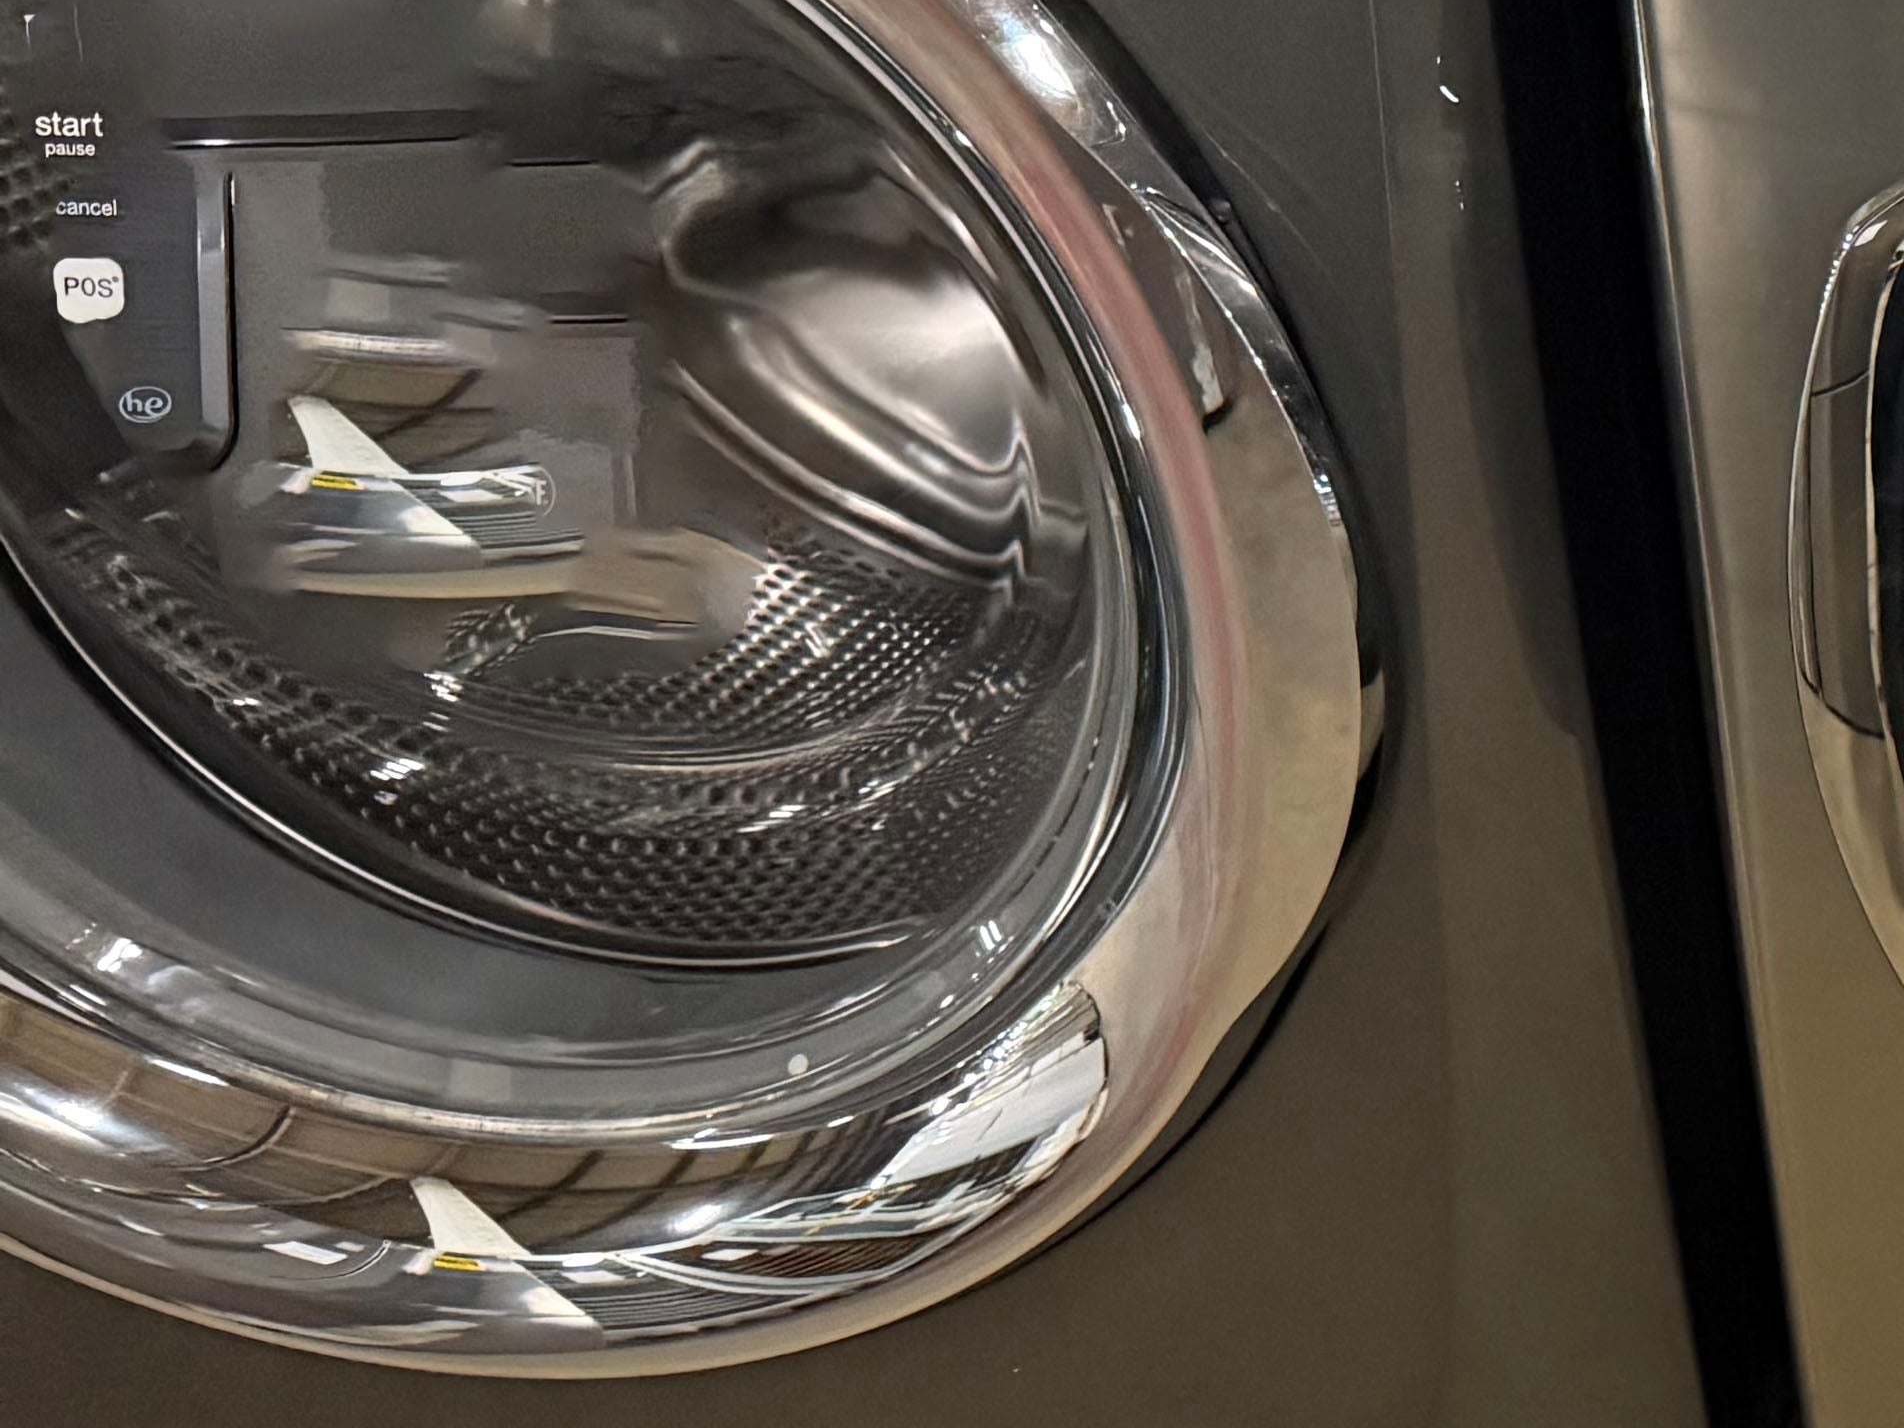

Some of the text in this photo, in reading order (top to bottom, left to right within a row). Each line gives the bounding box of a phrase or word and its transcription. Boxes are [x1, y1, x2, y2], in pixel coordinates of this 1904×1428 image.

[35, 112, 103, 138] start
[45, 141, 96, 158] pause
[55, 199, 117, 218] cancel
